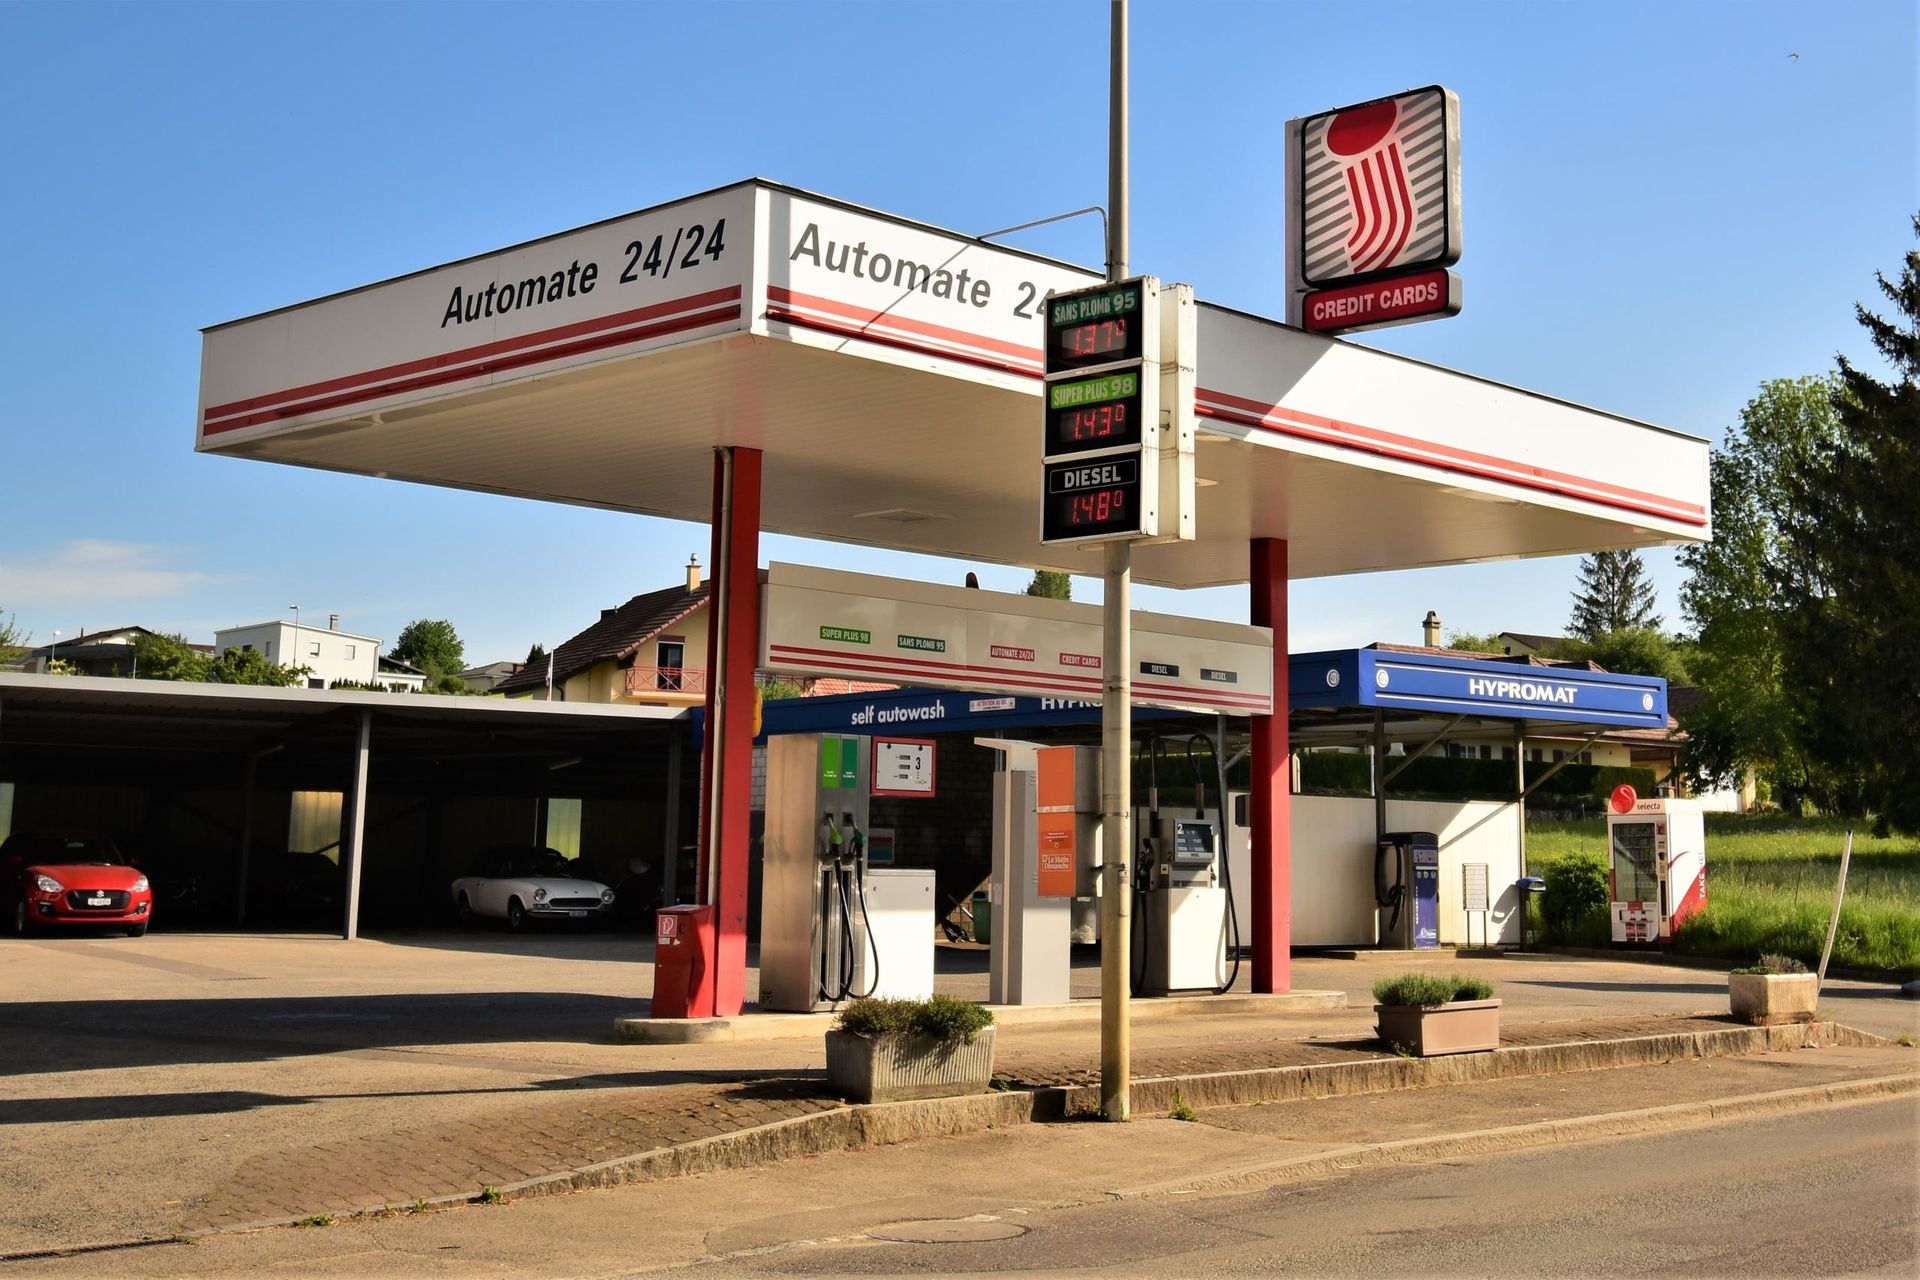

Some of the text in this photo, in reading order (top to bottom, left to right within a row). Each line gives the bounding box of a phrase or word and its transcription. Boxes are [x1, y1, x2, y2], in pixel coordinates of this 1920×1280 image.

[789, 222, 992, 308] Automate
[442, 218, 726, 329] Automate 24/24
[1054, 291, 1135, 323] SANS PLOMB 95
[1313, 282, 1438, 320] CREDIT CARDS
[1054, 377, 1133, 406] SUPER PLUS 98
[1064, 465, 1121, 488] DIESEL
[822, 628, 869, 642] SUPER PLUS 98
[899, 637, 944, 651] SANS PLOMB 95
[991, 647, 1034, 661] AUTOMATE 24/24
[1062, 655, 1099, 667] CREDIT CARDS
[1151, 665, 1168, 674] DIESEL
[1211, 671, 1227, 681] DIESEL
[1469, 678, 1578, 704] HYPROMAT
[851, 700, 945, 726] self autowash
[915, 757, 921, 770] 3
[1637, 802, 1661, 811] selecta
[1177, 823, 1184, 835] 2
[1209, 825, 1214, 836] 1
